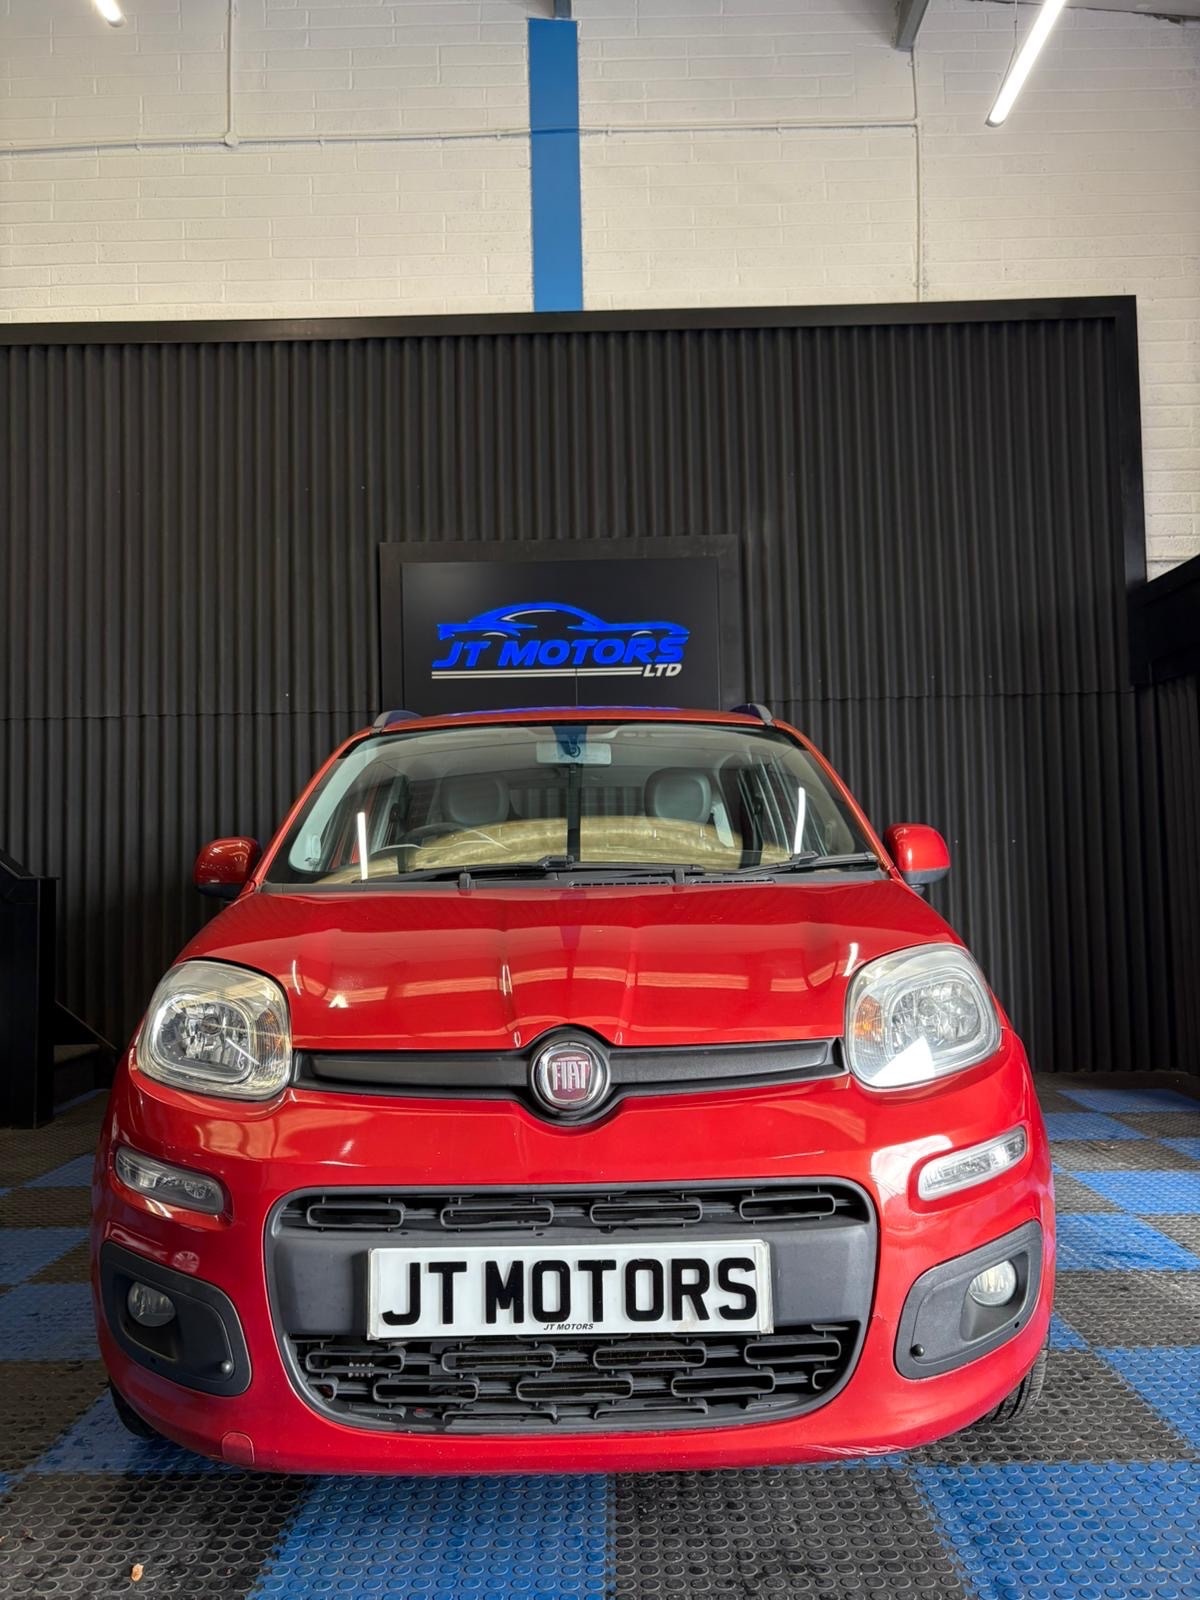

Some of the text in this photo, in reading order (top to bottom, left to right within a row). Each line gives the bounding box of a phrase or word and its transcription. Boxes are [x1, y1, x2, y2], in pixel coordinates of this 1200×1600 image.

[431, 637, 689, 667] JT MOTORS
[643, 663, 682, 677] LTD
[551, 1061, 588, 1091] FIAT
[381, 1257, 757, 1326] JT MOTORS
[543, 1323, 555, 1331] JT
